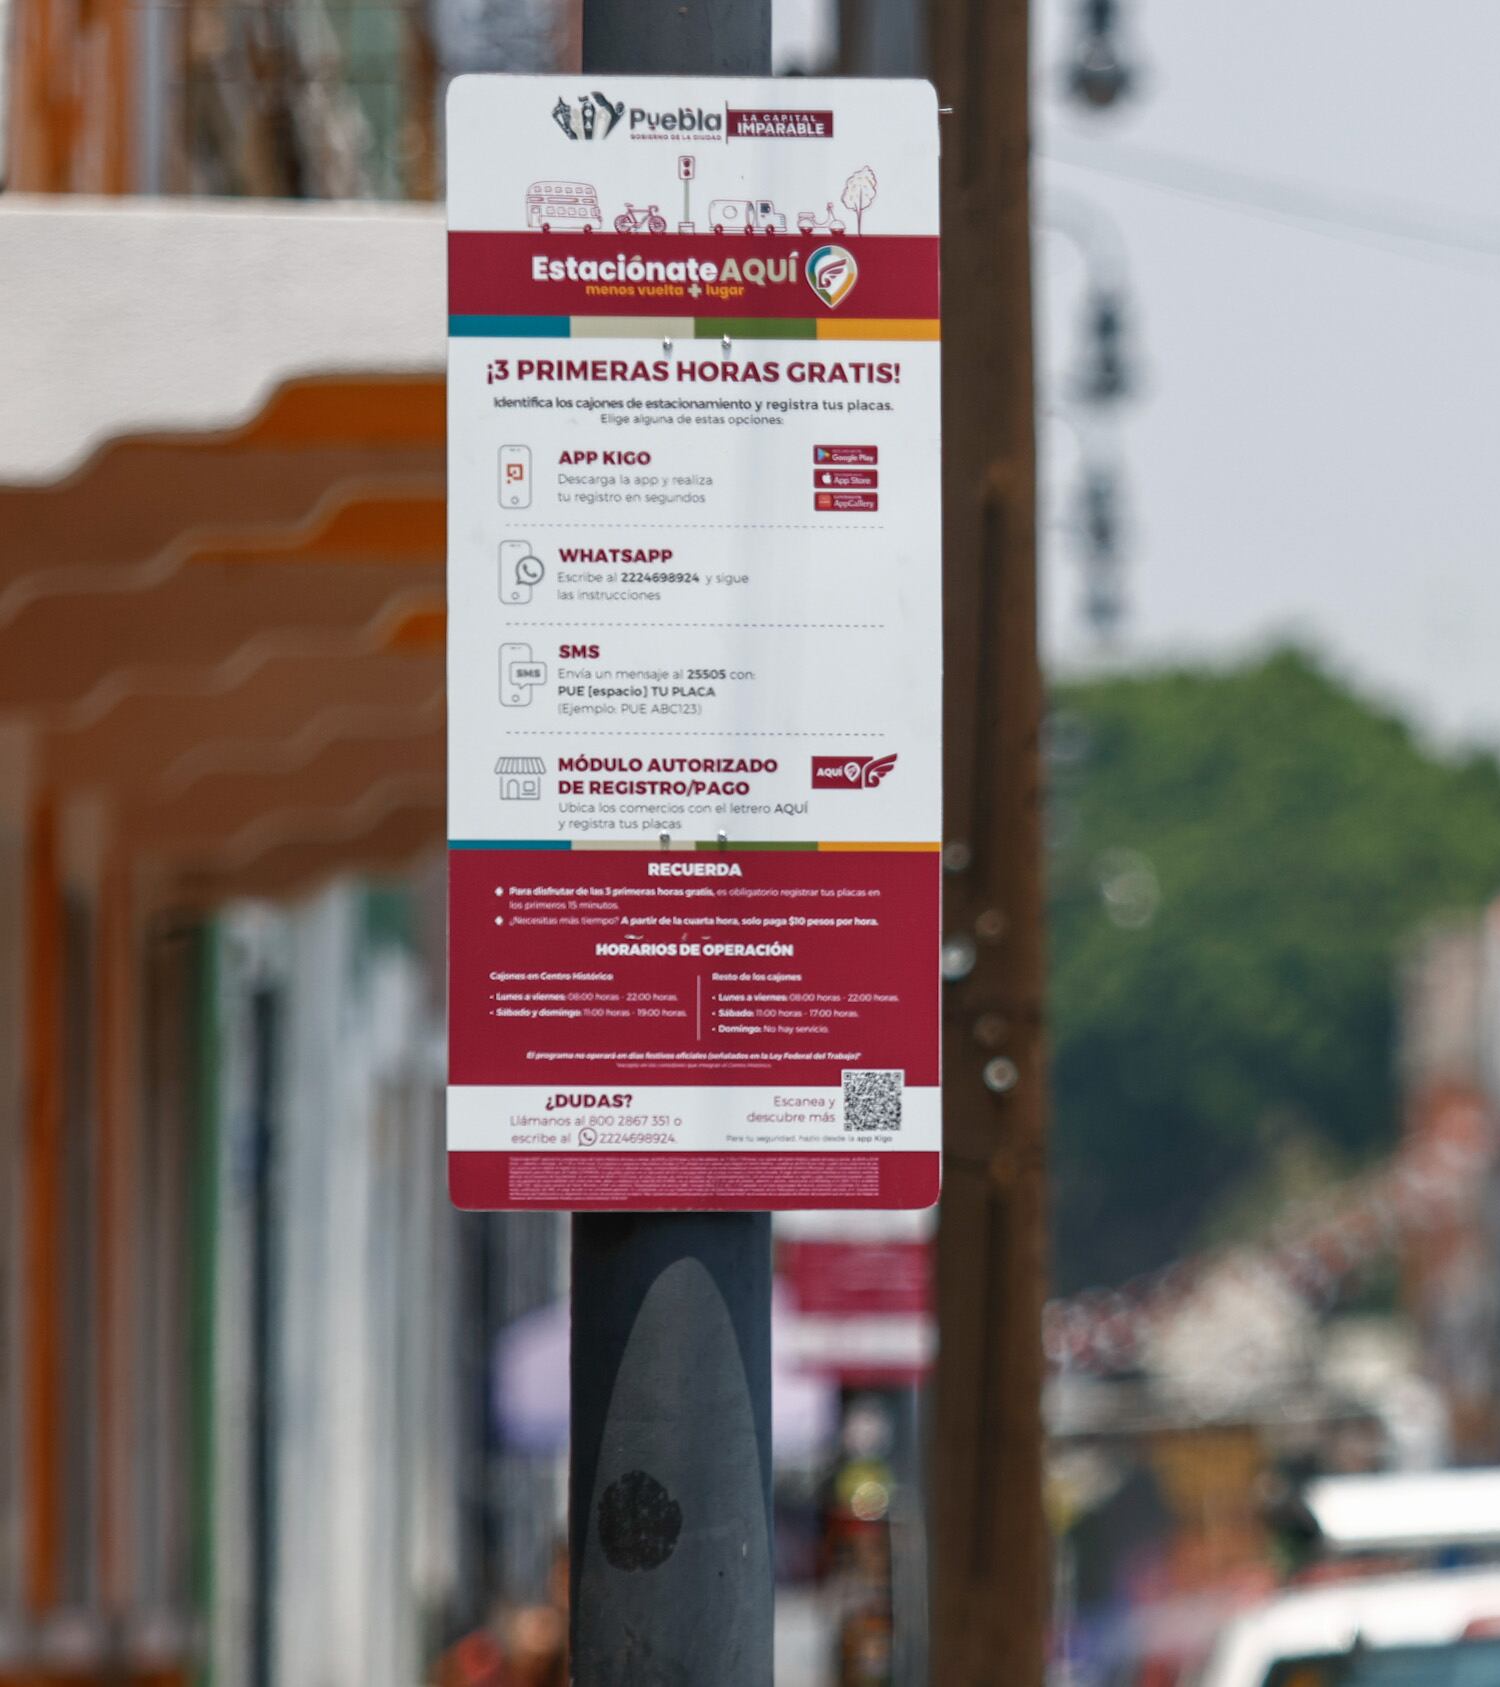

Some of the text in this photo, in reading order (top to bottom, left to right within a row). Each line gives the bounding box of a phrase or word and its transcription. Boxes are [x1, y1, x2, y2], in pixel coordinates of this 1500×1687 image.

[630, 108, 722, 131] Puebla
[741, 113, 818, 122] LA CAPITAL
[736, 122, 825, 136] IMPARABLE
[586, 285, 636, 295] menos
[637, 282, 685, 296] vuelta
[706, 282, 744, 299] lugar
[488, 360, 900, 384] ¡3 PRIMERAS HORAS GRATIS!
[494, 396, 894, 413] Identifica los cajones de estacionamiento y registra tus placas.
[600, 414, 784, 426] Elige alguna de estas opciones:
[559, 451, 651, 465] APP KIGO
[558, 473, 713, 487] Descarga la app y realiza
[832, 476, 872, 485] App Store
[557, 492, 706, 505] tu registro en segundos
[559, 549, 673, 563] WHATSAPP
[557, 572, 749, 586] Escribe al 2224698924 y sigue
[557, 590, 661, 600] las instrucciones
[559, 645, 600, 659] SMS
[516, 669, 541, 678] SMS
[558, 668, 755, 682] Envía un mensaje al 25505 con:
[558, 685, 716, 698] PUE [espacio] TU PLACA
[621, 703, 647, 714] PUE
[650, 704, 702, 715] ABC123)
[558, 754, 778, 773] MÓDULO AUTORIZADO
[817, 766, 843, 778] AQUÍ
[559, 779, 750, 796] DE REGISTRO/PAGO
[559, 801, 808, 816] Ubica los comercios con el letrero AQUÍ
[558, 819, 682, 833] y registra tus placas
[648, 863, 742, 876] RECUERDA
[509, 887, 533, 896] Para
[532, 887, 575, 896] disfrutar
[575, 887, 589, 896] de
[590, 887, 605, 896] las
[604, 887, 612, 895] 3
[611, 887, 656, 897] primeras
[657, 887, 684, 896] horas
[684, 887, 715, 897] gratis,
[728, 888, 779, 898] obligatorio
[780, 888, 819, 898] registrar
[837, 888, 867, 897] placas
[682, 917, 715, 925] cuarta
[716, 917, 740, 925] hora,
[741, 917, 762, 925] solo
[763, 918, 789, 927] paga
[788, 916, 806, 926] $10
[807, 918, 835, 927] pesos
[836, 919, 853, 927] por
[854, 917, 878, 926] hora.
[596, 941, 794, 956] HORARIOS DE OPERACIÓN
[489, 972, 526, 981] Cajones
[540, 972, 572, 980] Centro
[571, 972, 614, 980] Histórico
[712, 972, 802, 982] Resto de los cajones
[718, 1024, 762, 1034] Domingo:
[763, 1025, 777, 1033] No
[776, 1025, 794, 1034] hay
[545, 1094, 632, 1111] ¿DUDAS?
[774, 1096, 835, 1109] Escanea y
[510, 1114, 682, 1127] Llámanos al 800 2867 351 o
[746, 1112, 835, 1123] descubre más
[511, 1133, 571, 1144] escribe al
